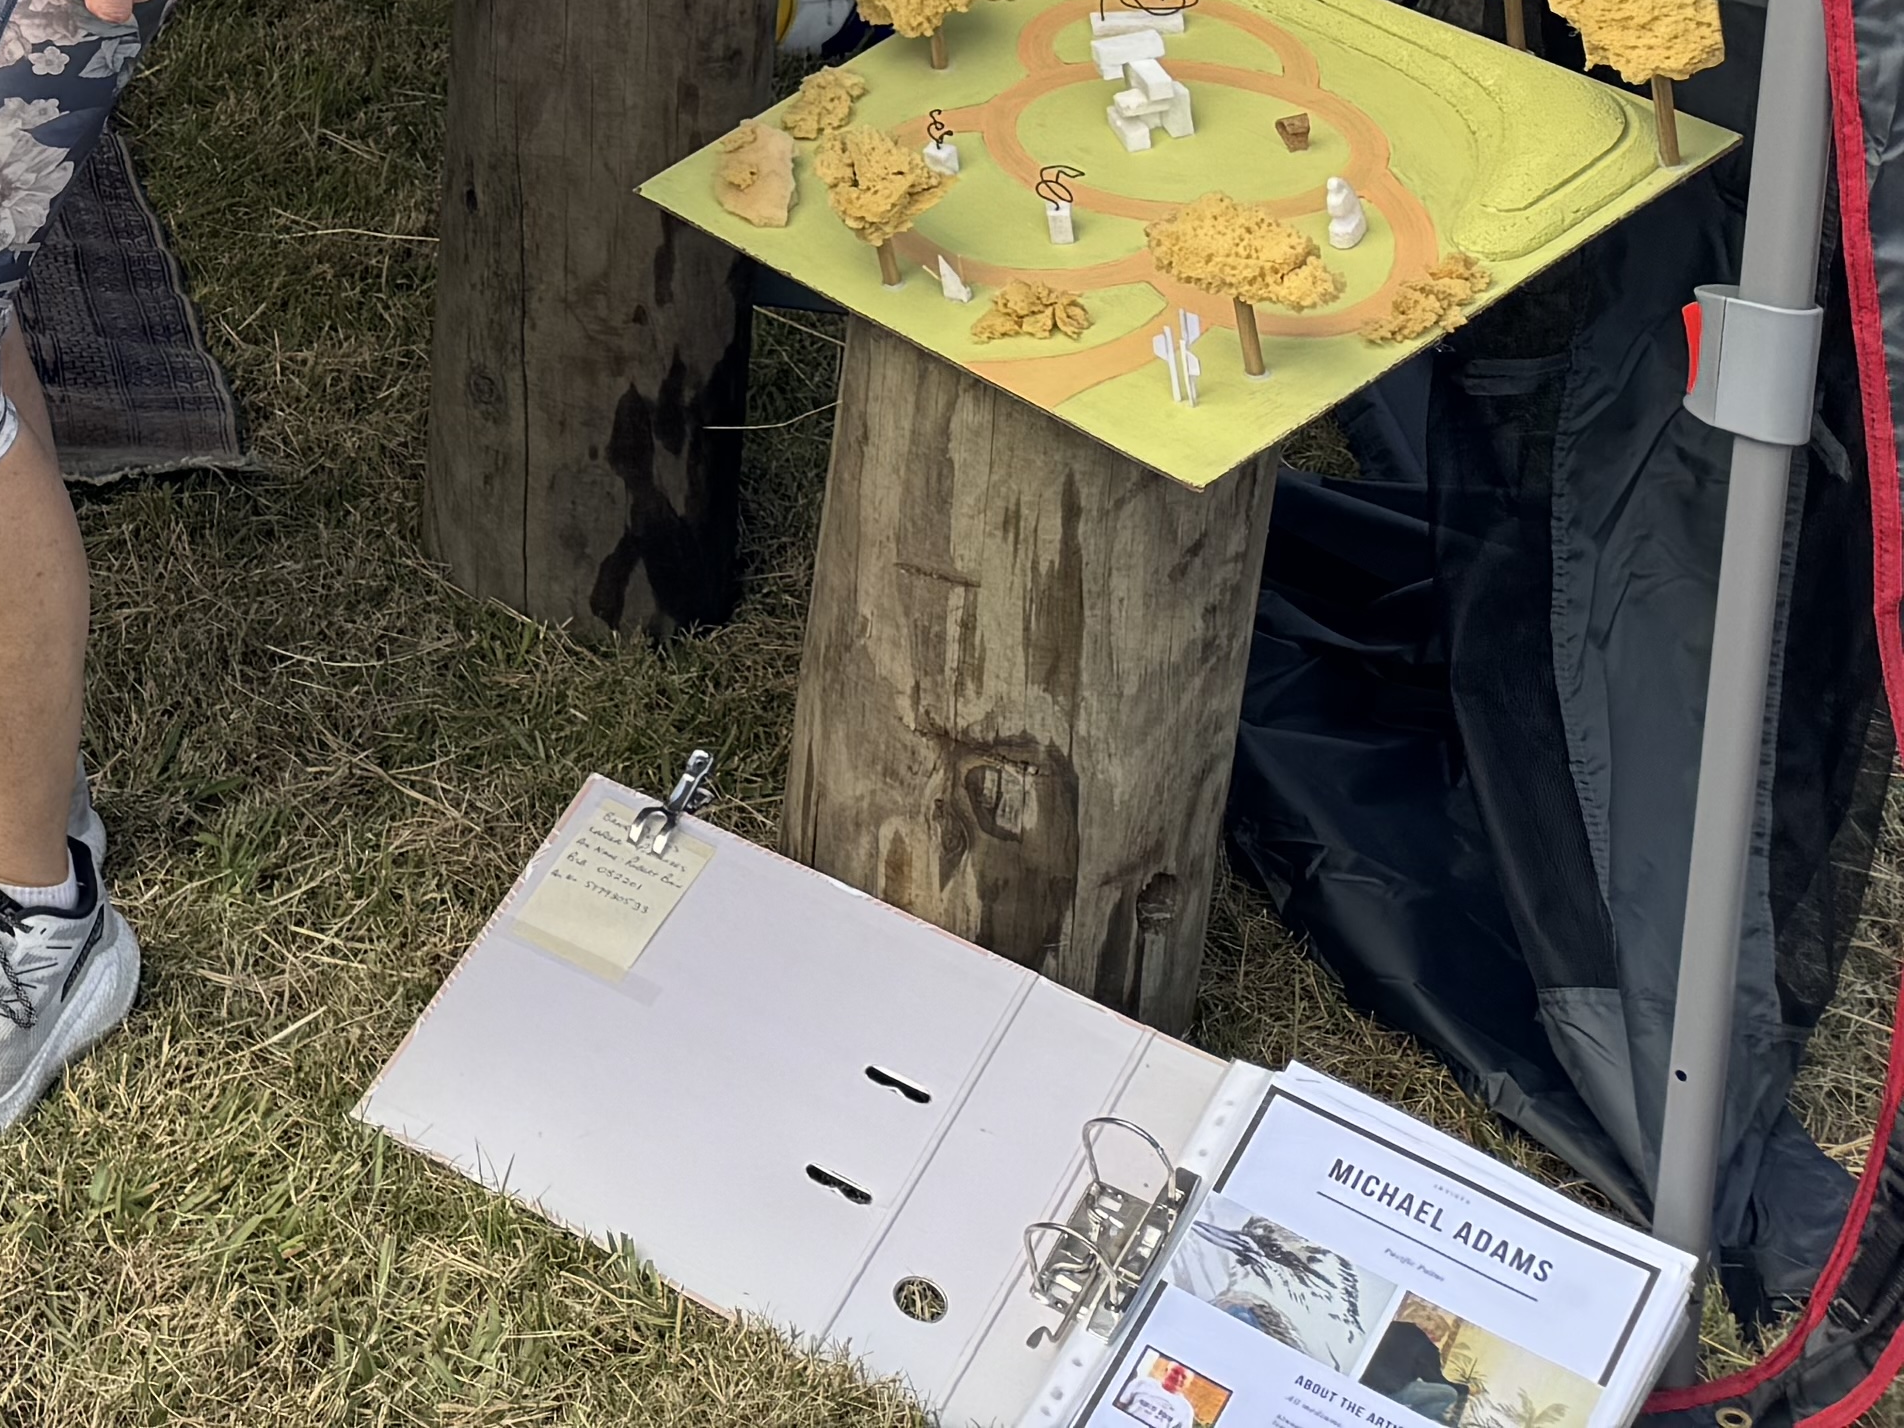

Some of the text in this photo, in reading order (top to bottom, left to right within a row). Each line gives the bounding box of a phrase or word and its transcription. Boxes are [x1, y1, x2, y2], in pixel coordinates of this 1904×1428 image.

[1327, 1157, 1554, 1283] MICHAEL ADAMS
[1294, 1375, 1404, 1428] ABOUT THE ART
